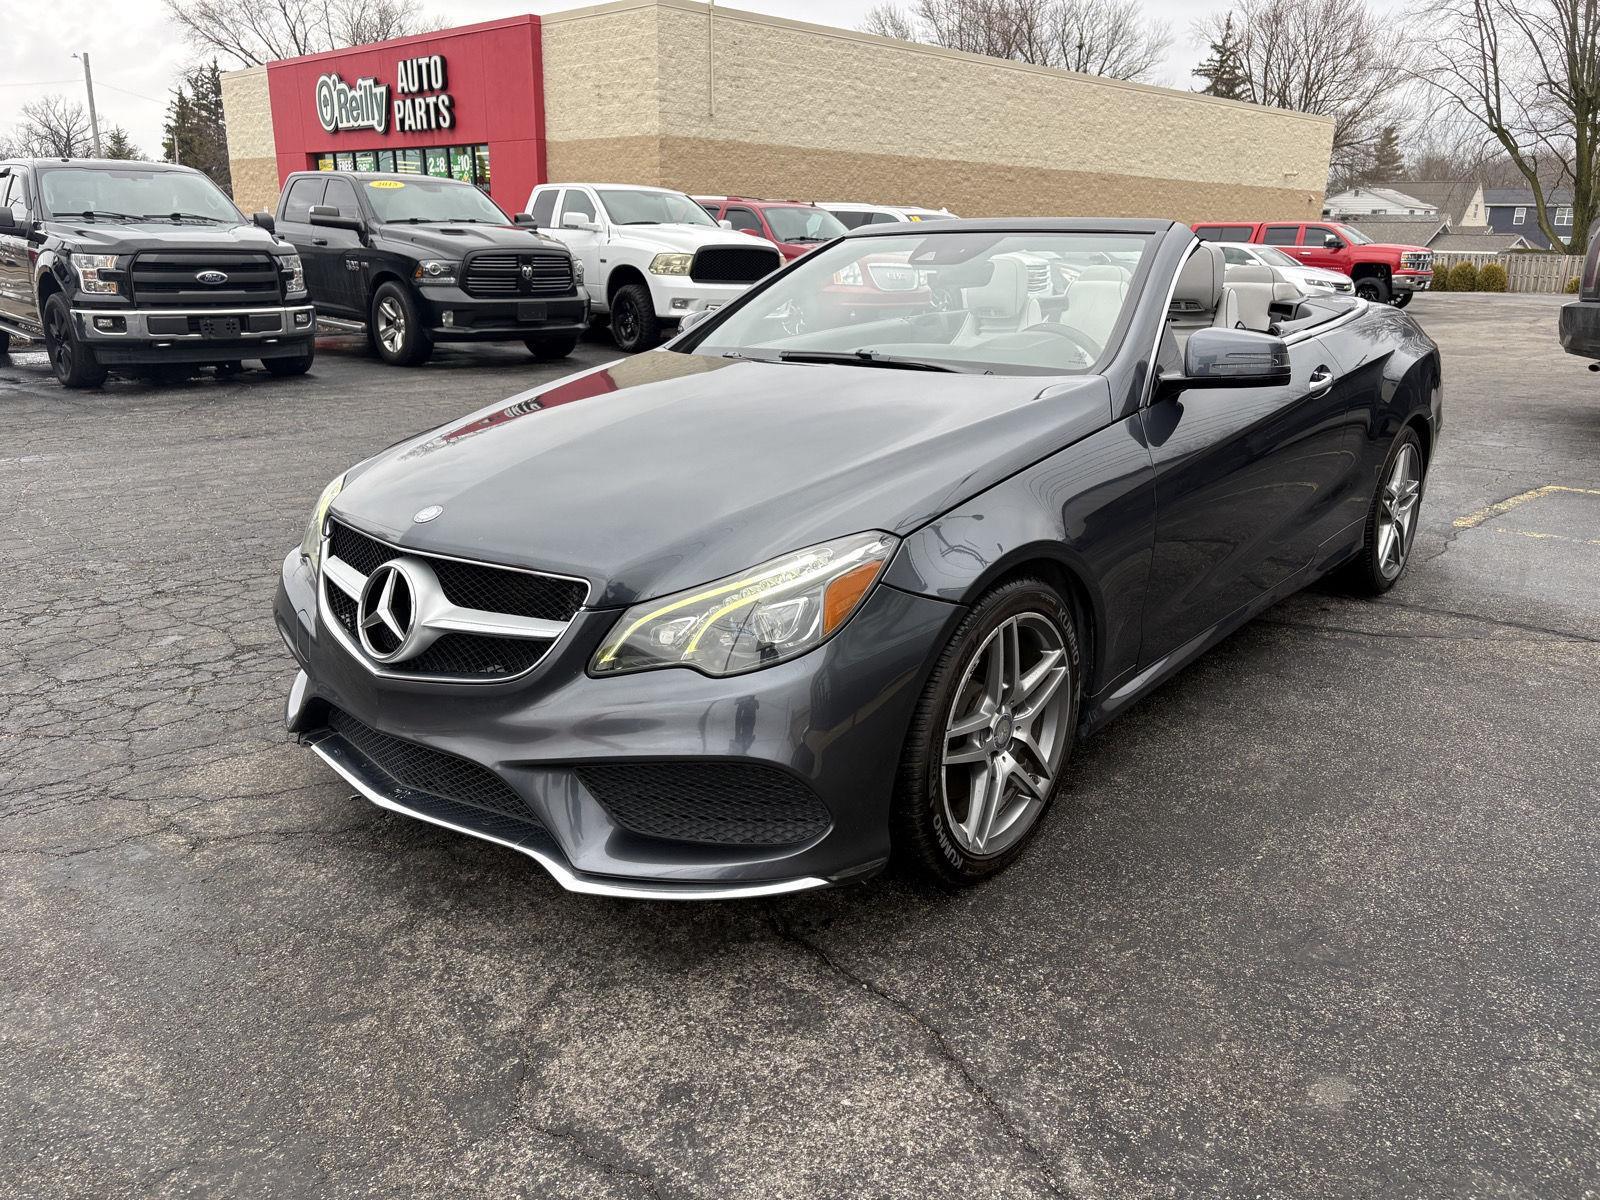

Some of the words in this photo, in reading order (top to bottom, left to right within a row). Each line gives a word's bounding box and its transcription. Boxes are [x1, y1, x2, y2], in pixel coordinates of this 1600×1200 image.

[397, 55, 444, 94] AUTO
[316, 74, 388, 133] O'Reilly
[394, 95, 452, 132] PARTS
[339, 160, 352, 171] FREE
[203, 273, 222, 281] Ford
[1057, 607, 1080, 666] KUMHO
[933, 814, 963, 869] KUMHO
